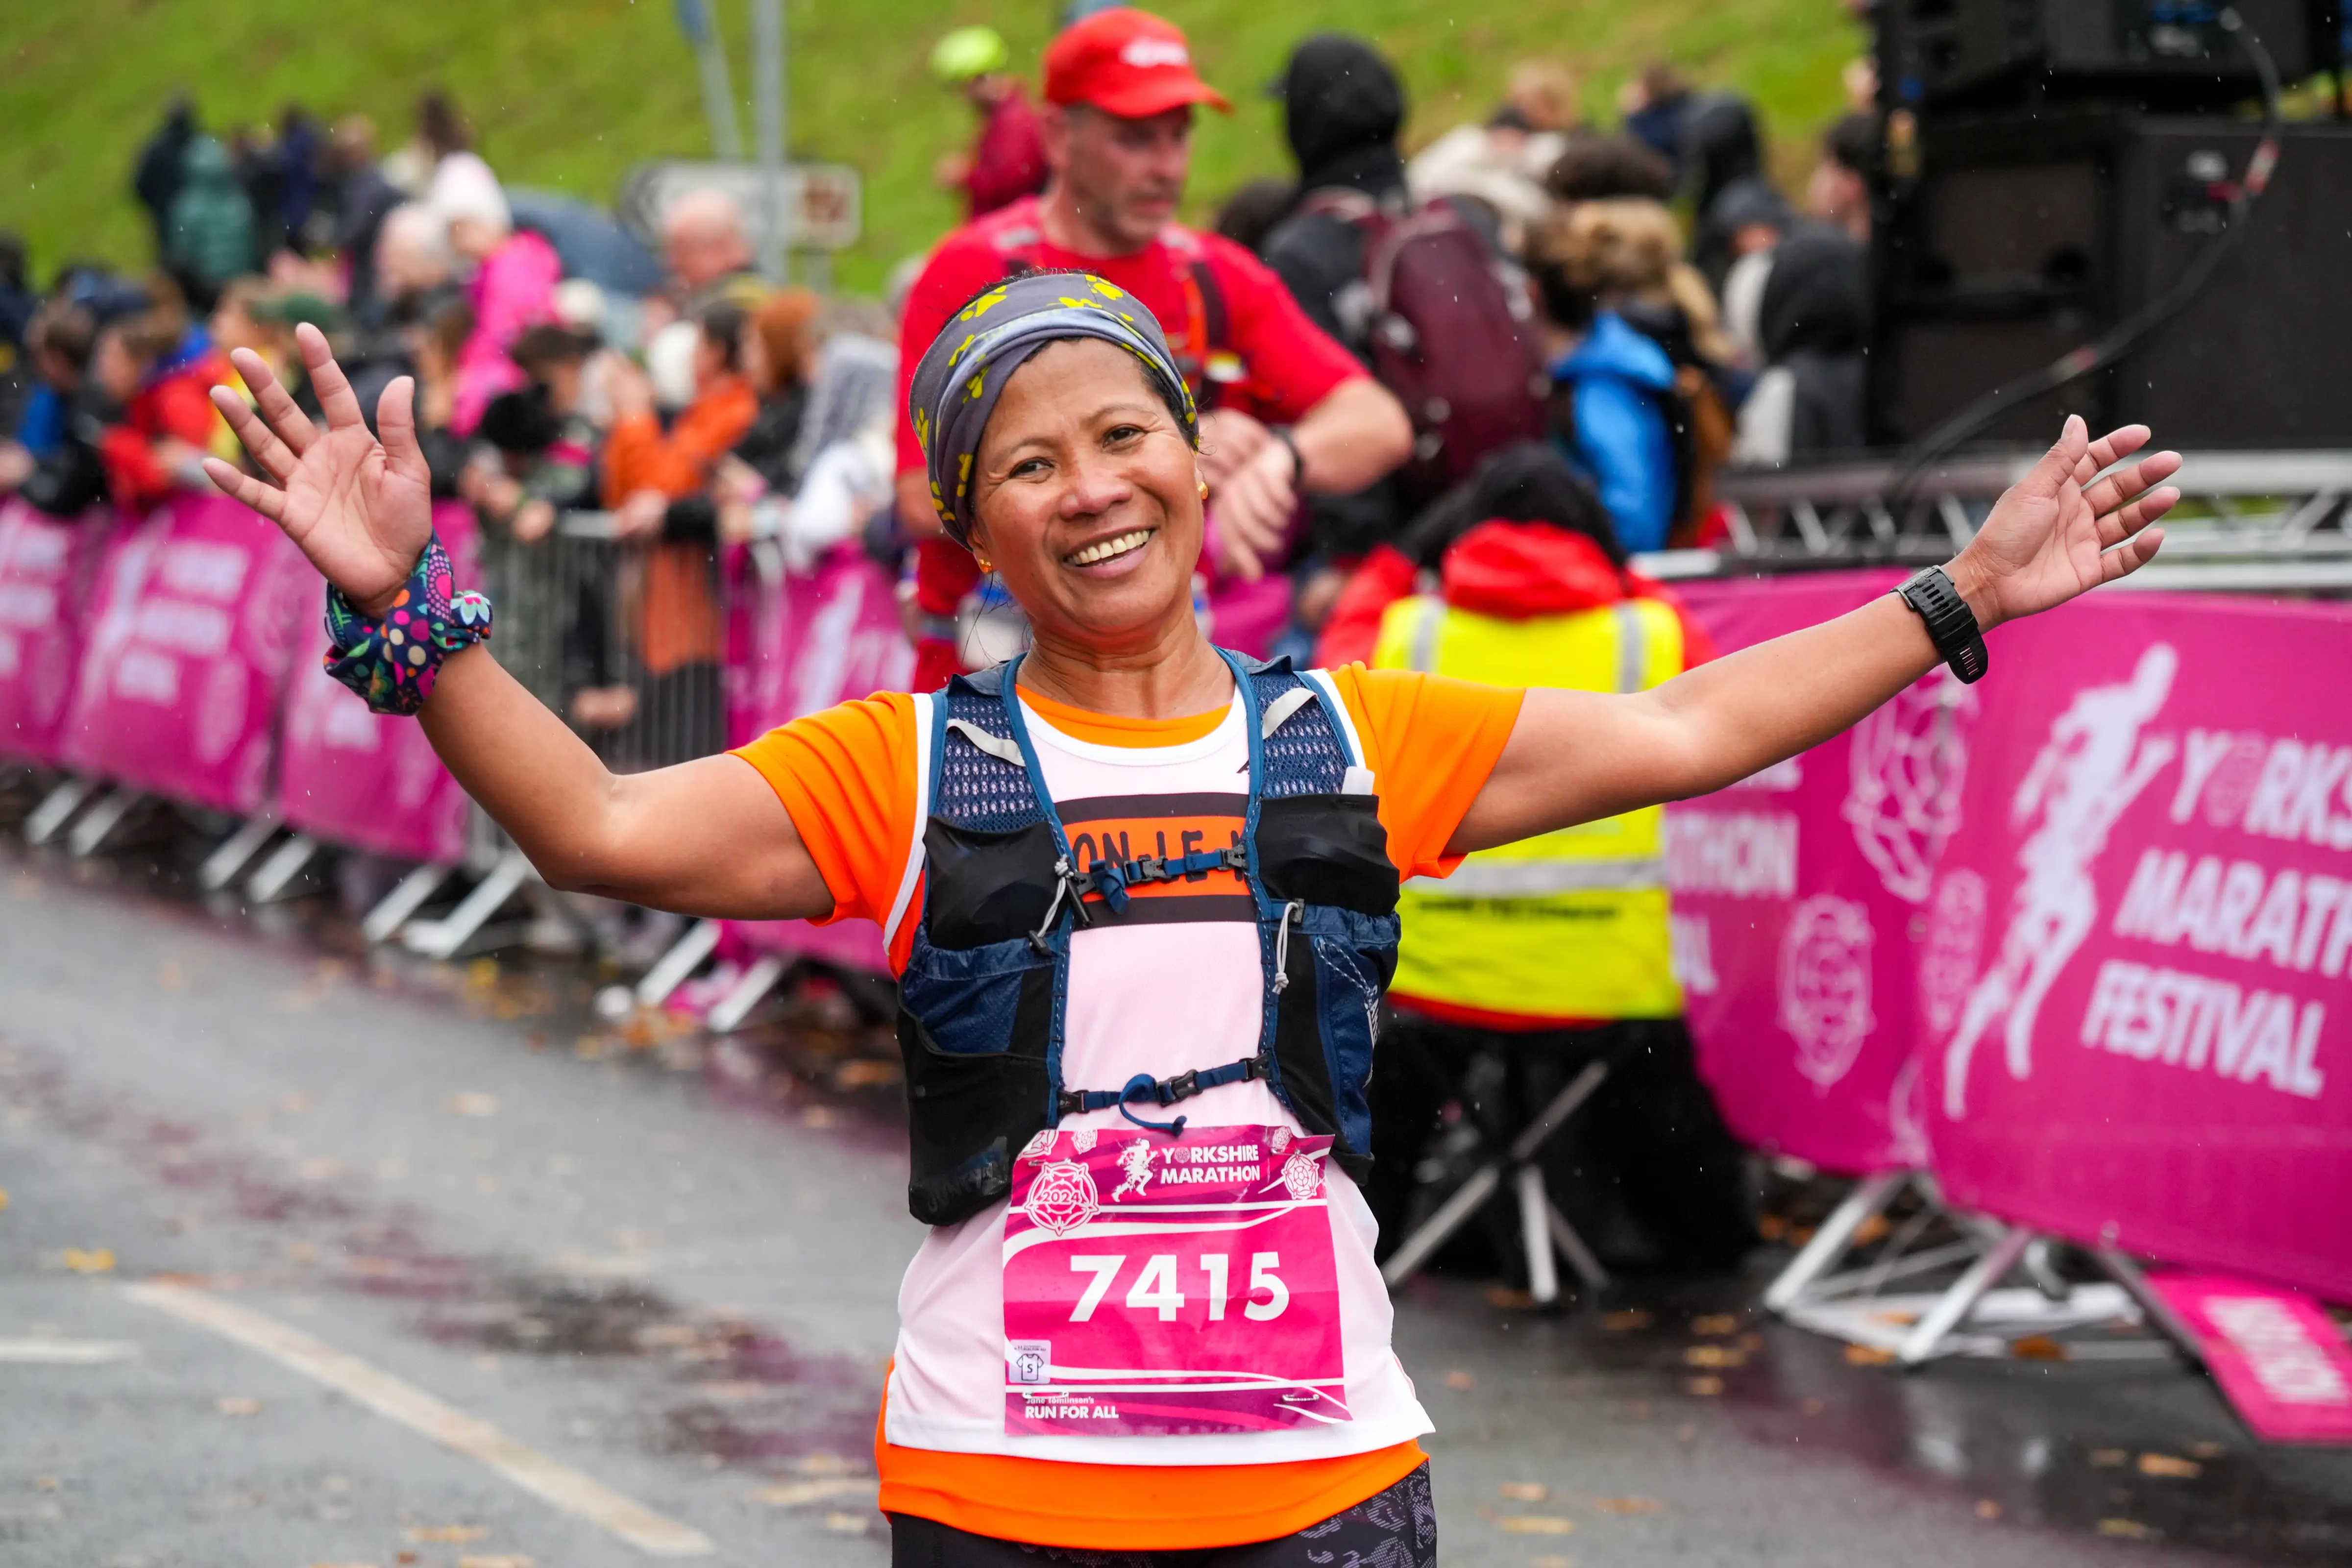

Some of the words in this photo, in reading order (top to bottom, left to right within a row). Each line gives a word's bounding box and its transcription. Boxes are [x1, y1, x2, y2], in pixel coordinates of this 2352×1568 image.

[2080, 958, 2326, 1100] FESTIVAL
[1161, 1144, 1259, 1164] YORKSHIRE
[1160, 1165, 1260, 1184] MARATHON
[1042, 1191, 1081, 1202] 2024
[1069, 1251, 1290, 1323] 7415
[1027, 1363, 1033, 1373] S
[1025, 1406, 1056, 1419] RUN
[1059, 1406, 1089, 1419] FOR
[1092, 1406, 1119, 1419] ALL
